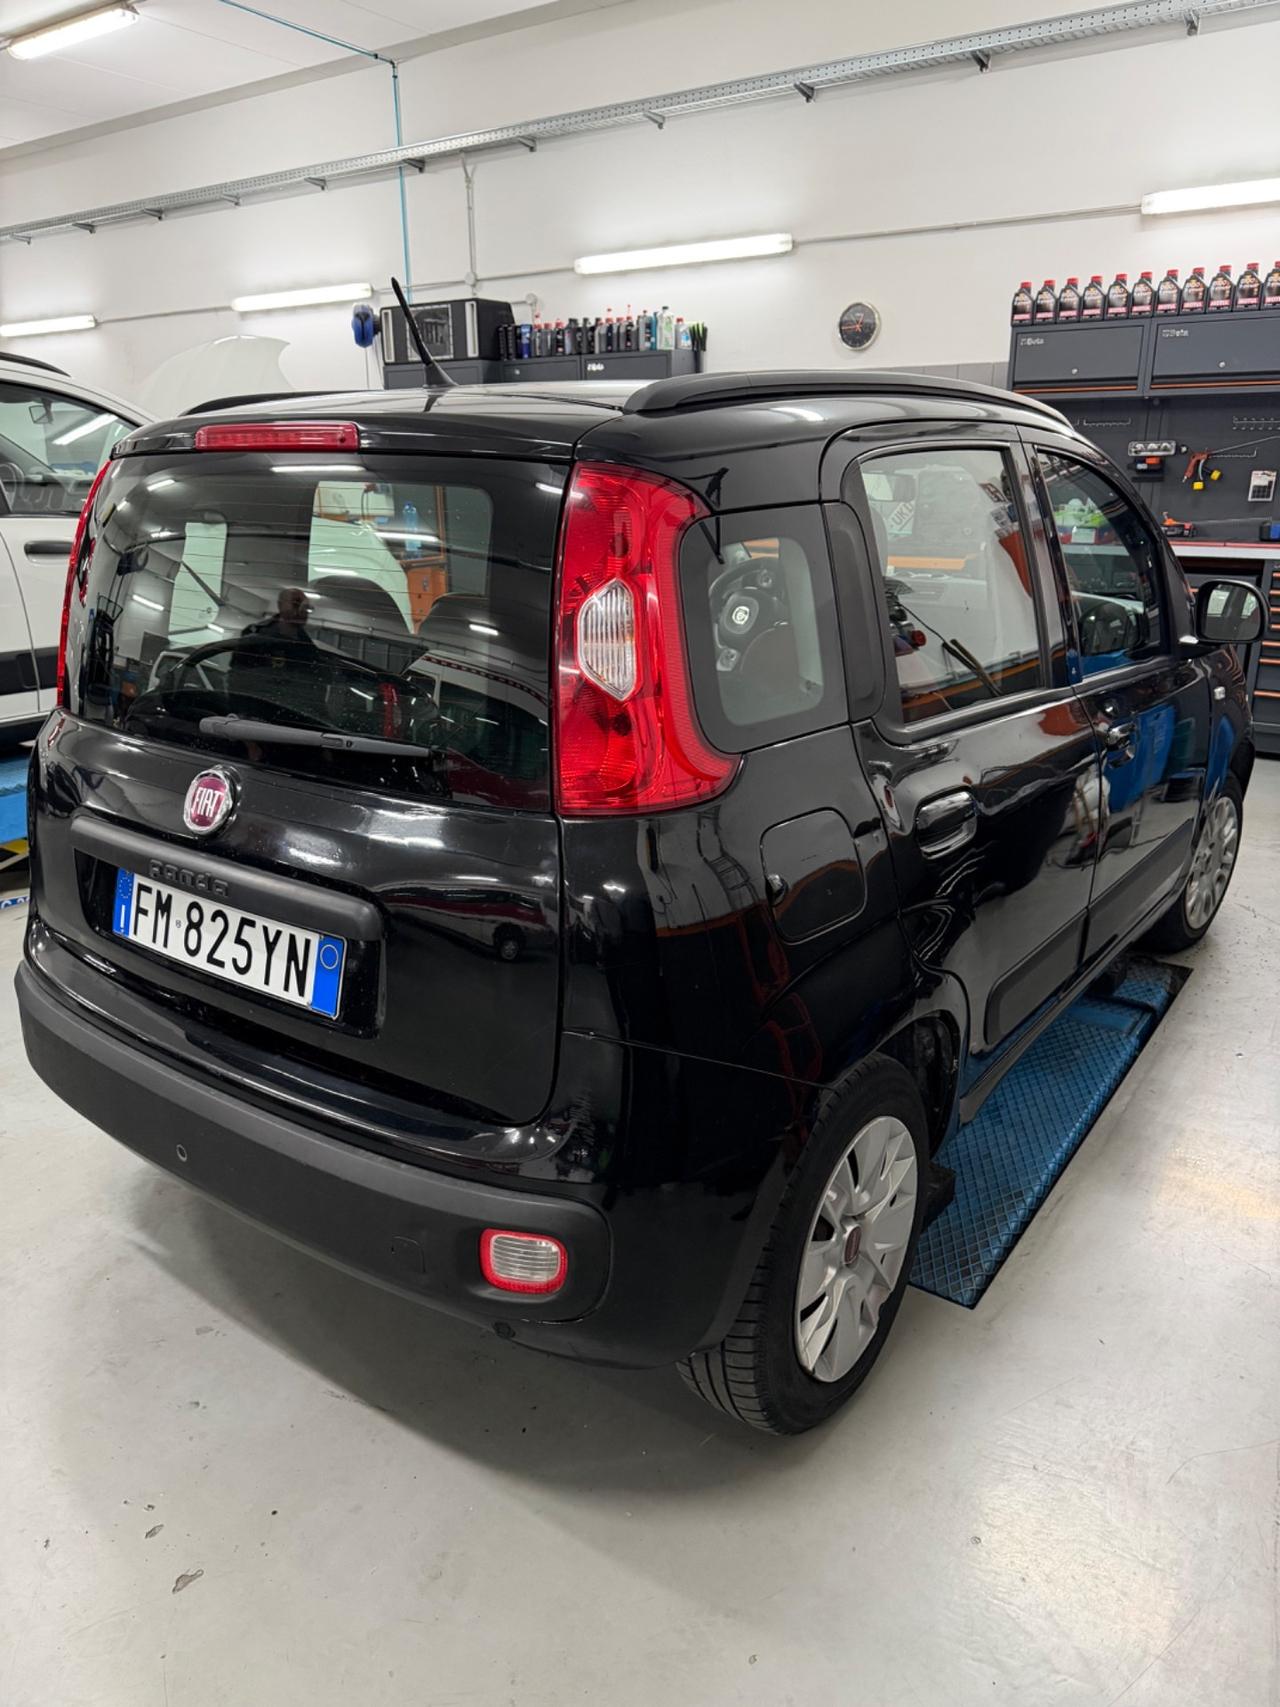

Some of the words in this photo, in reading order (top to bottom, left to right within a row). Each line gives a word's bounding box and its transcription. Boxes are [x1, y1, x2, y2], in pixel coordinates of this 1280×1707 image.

[190, 786, 226, 818] FIAT
[133, 882, 173, 949] FM
[183, 900, 311, 998] 825YN
